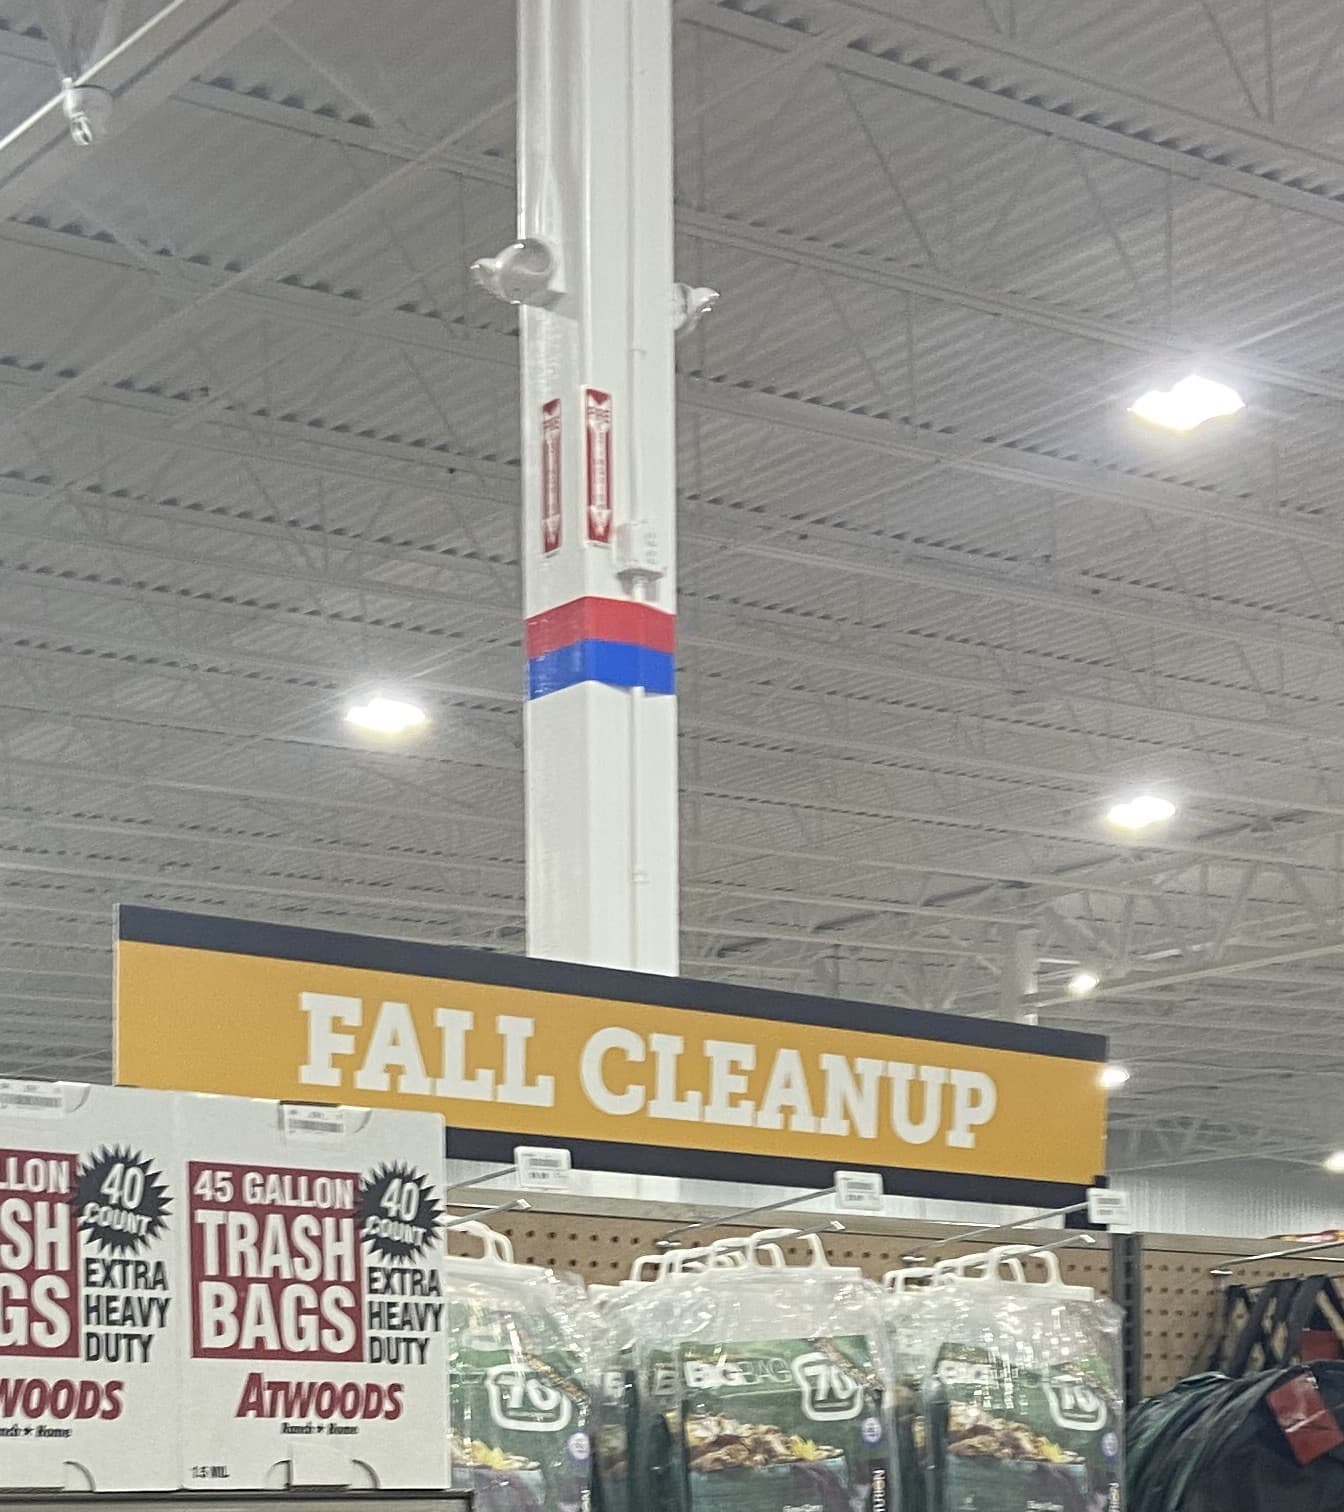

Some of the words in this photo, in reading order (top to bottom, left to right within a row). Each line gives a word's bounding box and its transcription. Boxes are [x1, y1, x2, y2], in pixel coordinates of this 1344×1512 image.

[297, 991, 554, 1107] FALL
[580, 1026, 997, 1149] CLEANUP
[102, 1163, 145, 1209] 40
[83, 1201, 152, 1237] COUNT
[85, 1258, 167, 1290] EXTRA
[84, 1294, 171, 1328] HEAVY
[85, 1332, 154, 1363] DUTY
